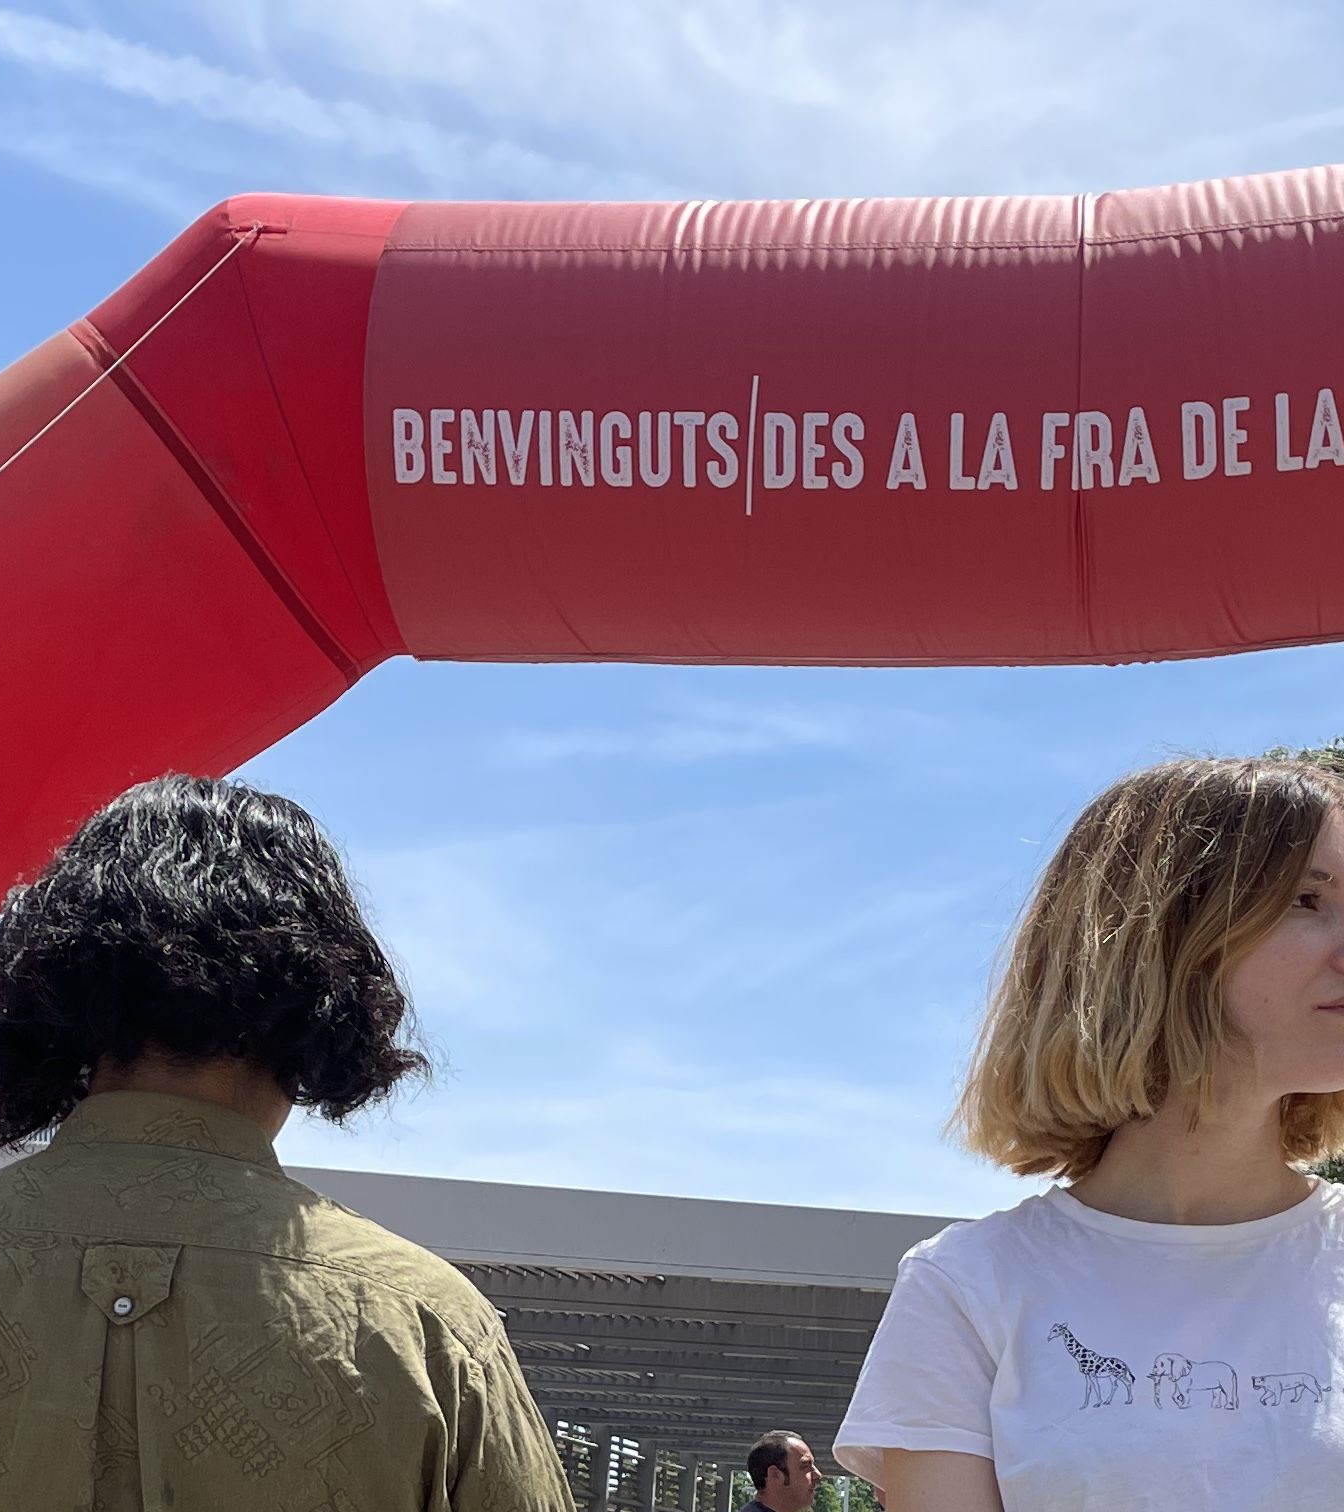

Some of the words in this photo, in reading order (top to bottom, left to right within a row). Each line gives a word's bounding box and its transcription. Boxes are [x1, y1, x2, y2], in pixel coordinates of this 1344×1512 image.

[886, 412, 927, 490] A
[949, 412, 1018, 490] LA
[1041, 407, 1160, 490] FRA
[1181, 396, 1252, 480] DE
